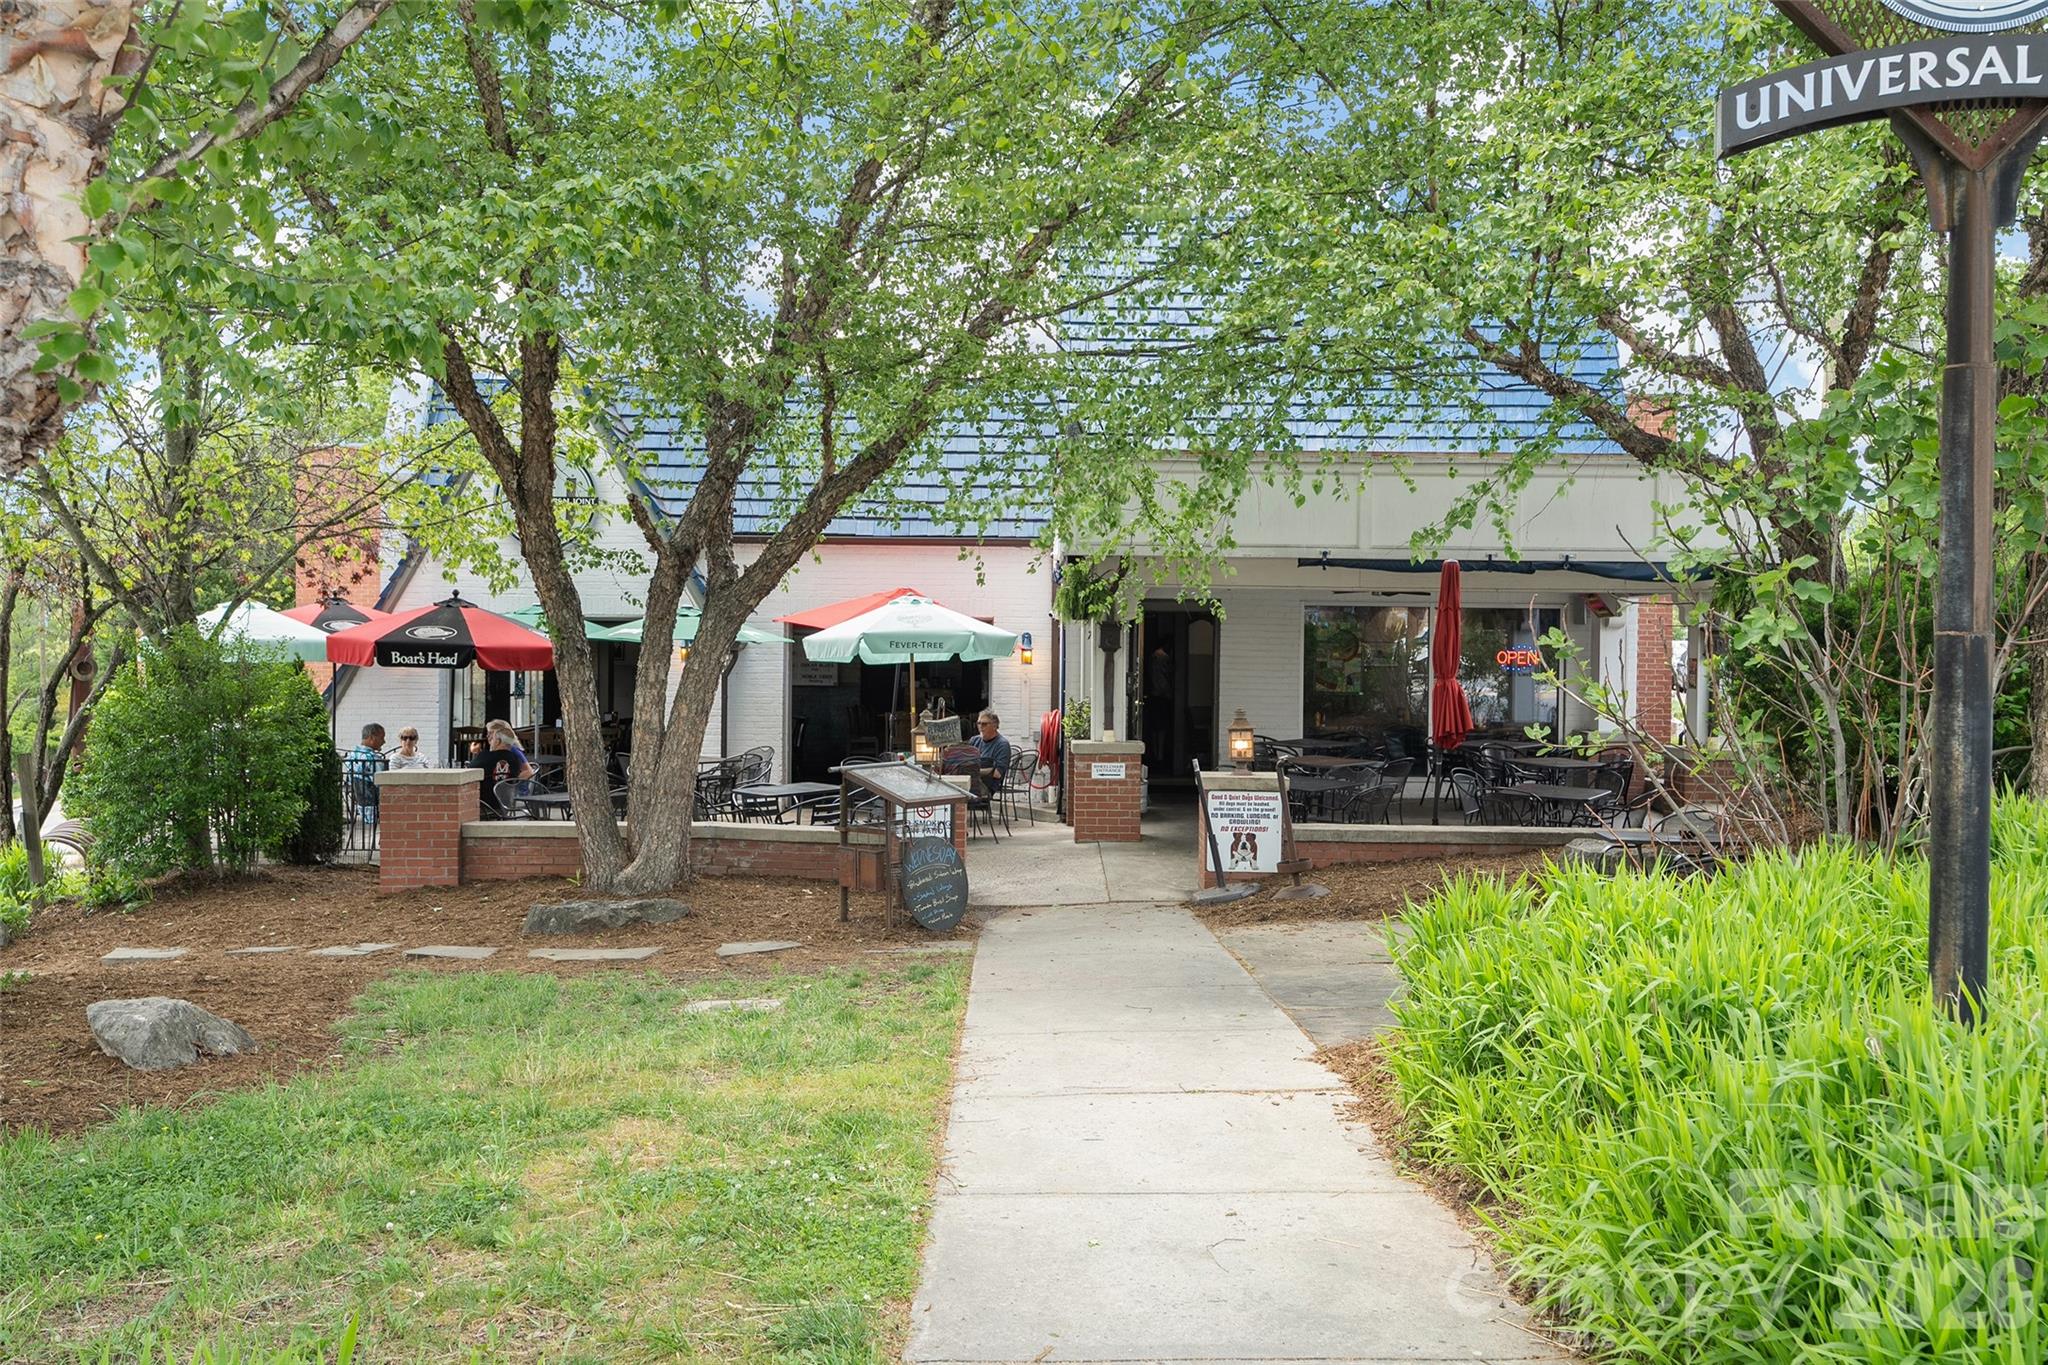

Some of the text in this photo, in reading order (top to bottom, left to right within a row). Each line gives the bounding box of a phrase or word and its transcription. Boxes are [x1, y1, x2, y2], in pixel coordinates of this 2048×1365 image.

[1735, 44, 2043, 130] UNIVERSAL
[889, 640, 944, 649] FEVER-TREE
[391, 651, 458, 665] Boar's Head
[1496, 650, 1538, 665] OPEN
